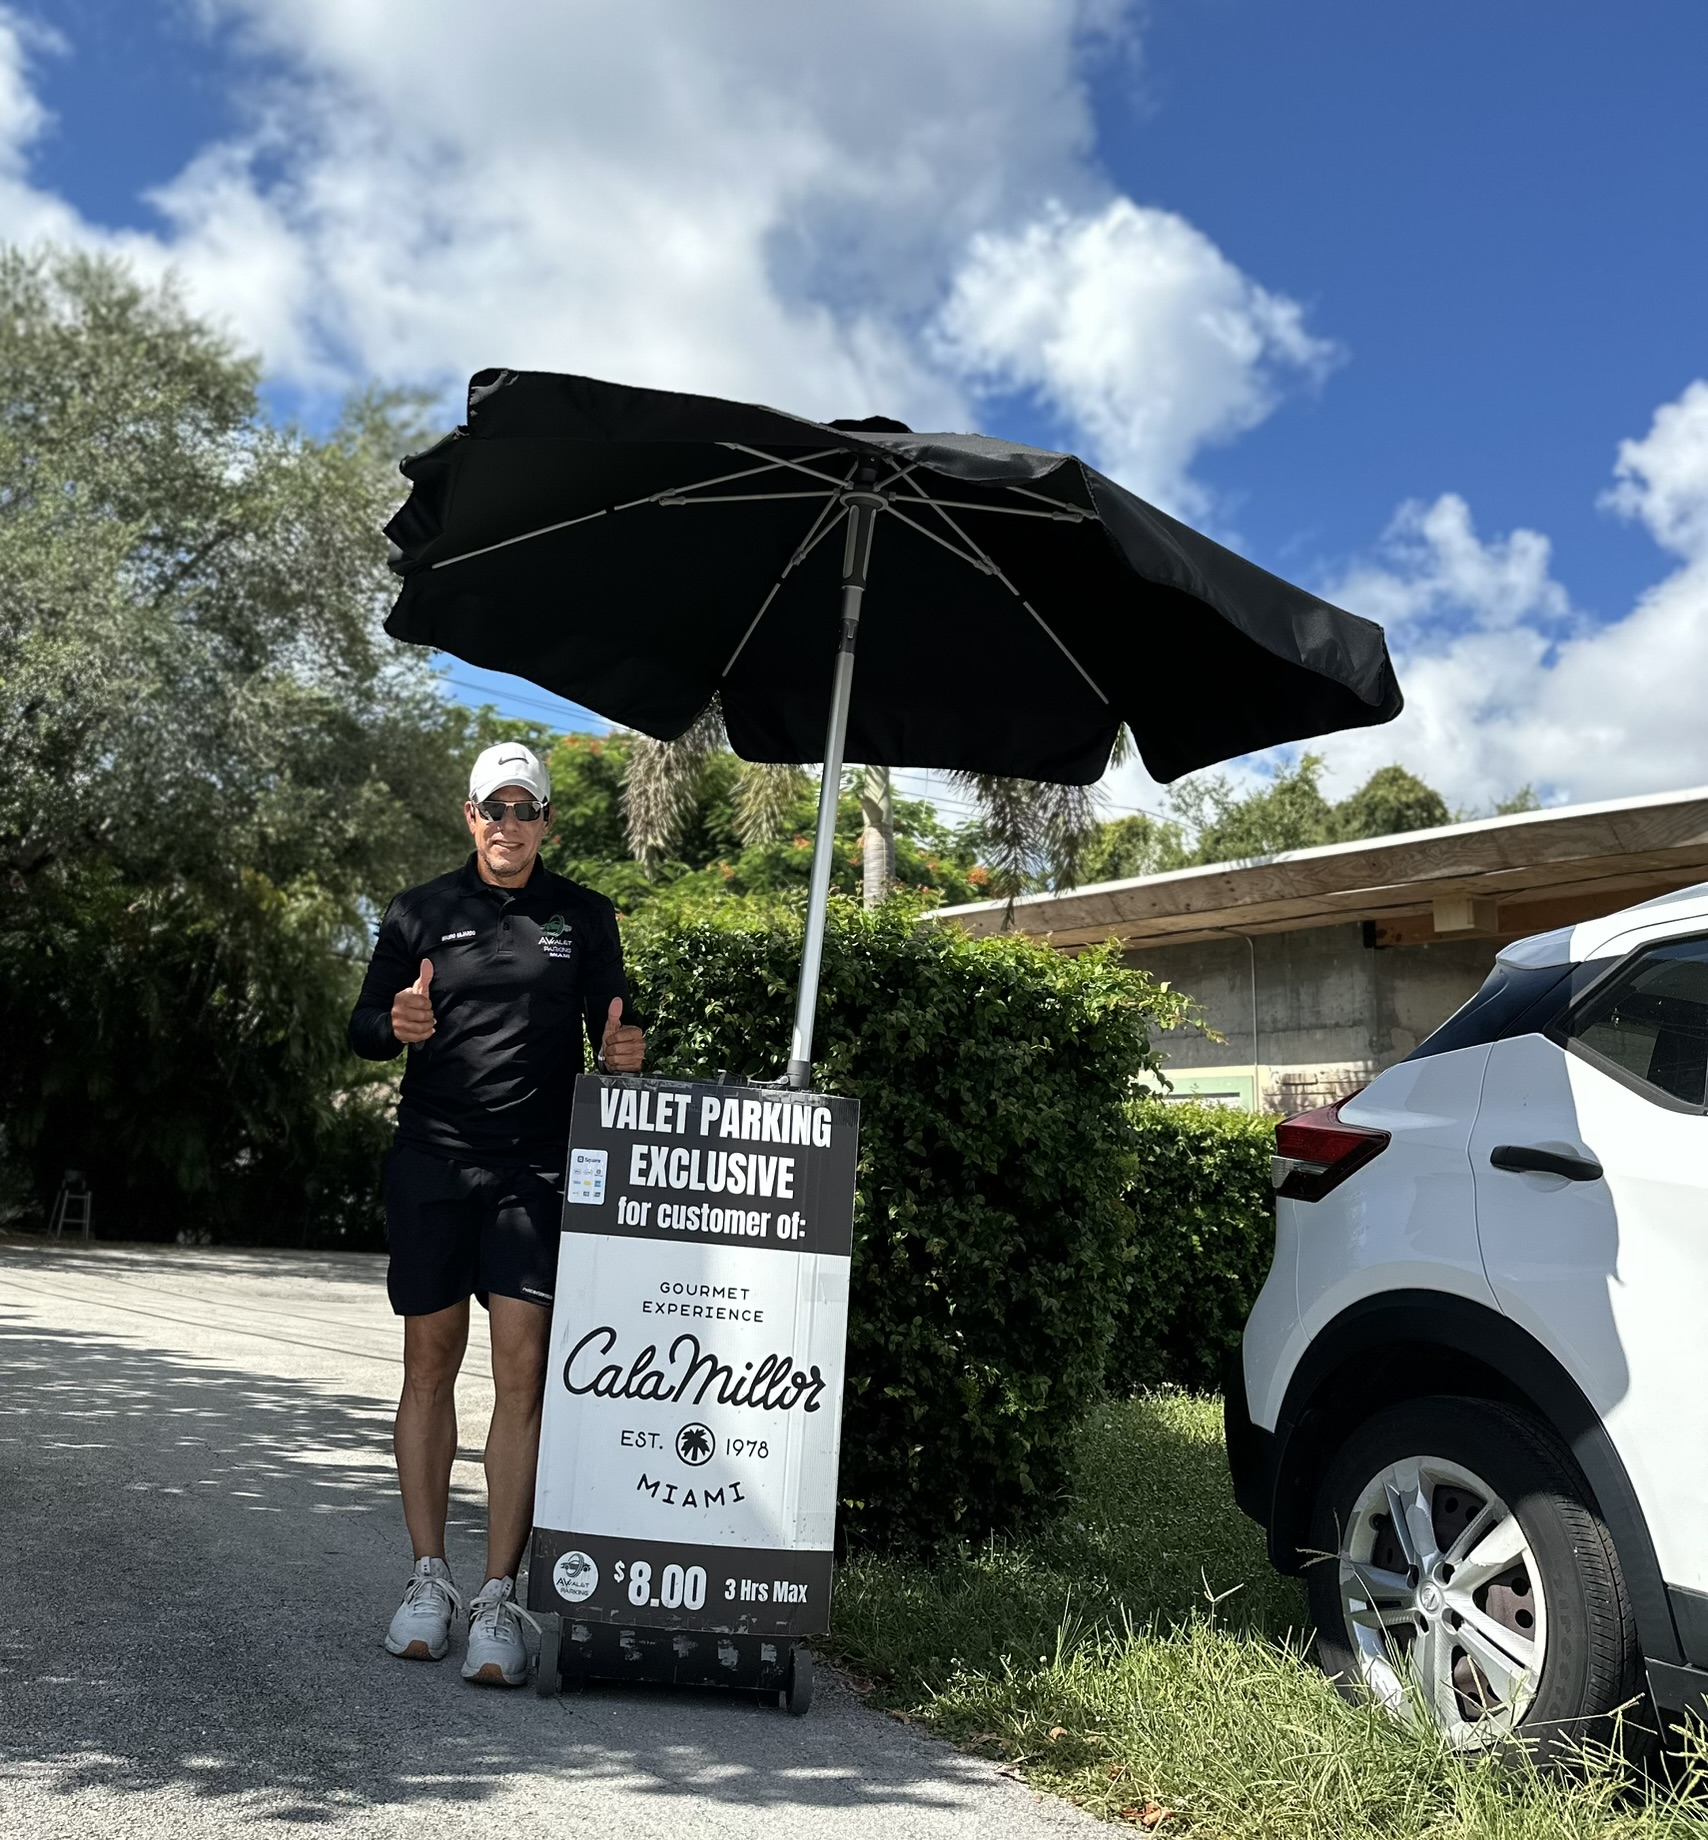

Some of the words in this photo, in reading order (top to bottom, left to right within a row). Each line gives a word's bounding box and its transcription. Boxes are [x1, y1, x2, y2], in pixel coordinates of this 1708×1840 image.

[600, 1087, 692, 1134] VALET
[700, 1096, 832, 1148] PARKING
[629, 1144, 795, 1199] EXCLUSIVE
[617, 1196, 651, 1226] for
[657, 1203, 771, 1237] customer
[776, 1211, 806, 1240] of:
[660, 1282, 750, 1300] GOURMET
[642, 1301, 764, 1322] EXPERIENCE
[620, 1430, 663, 1450] EST.
[726, 1438, 769, 1459] 1978
[637, 1473, 745, 1508] MIAMI
[724, 1578, 736, 1600] 3
[740, 1579, 769, 1602] Hrs
[773, 1581, 808, 1603] Max
